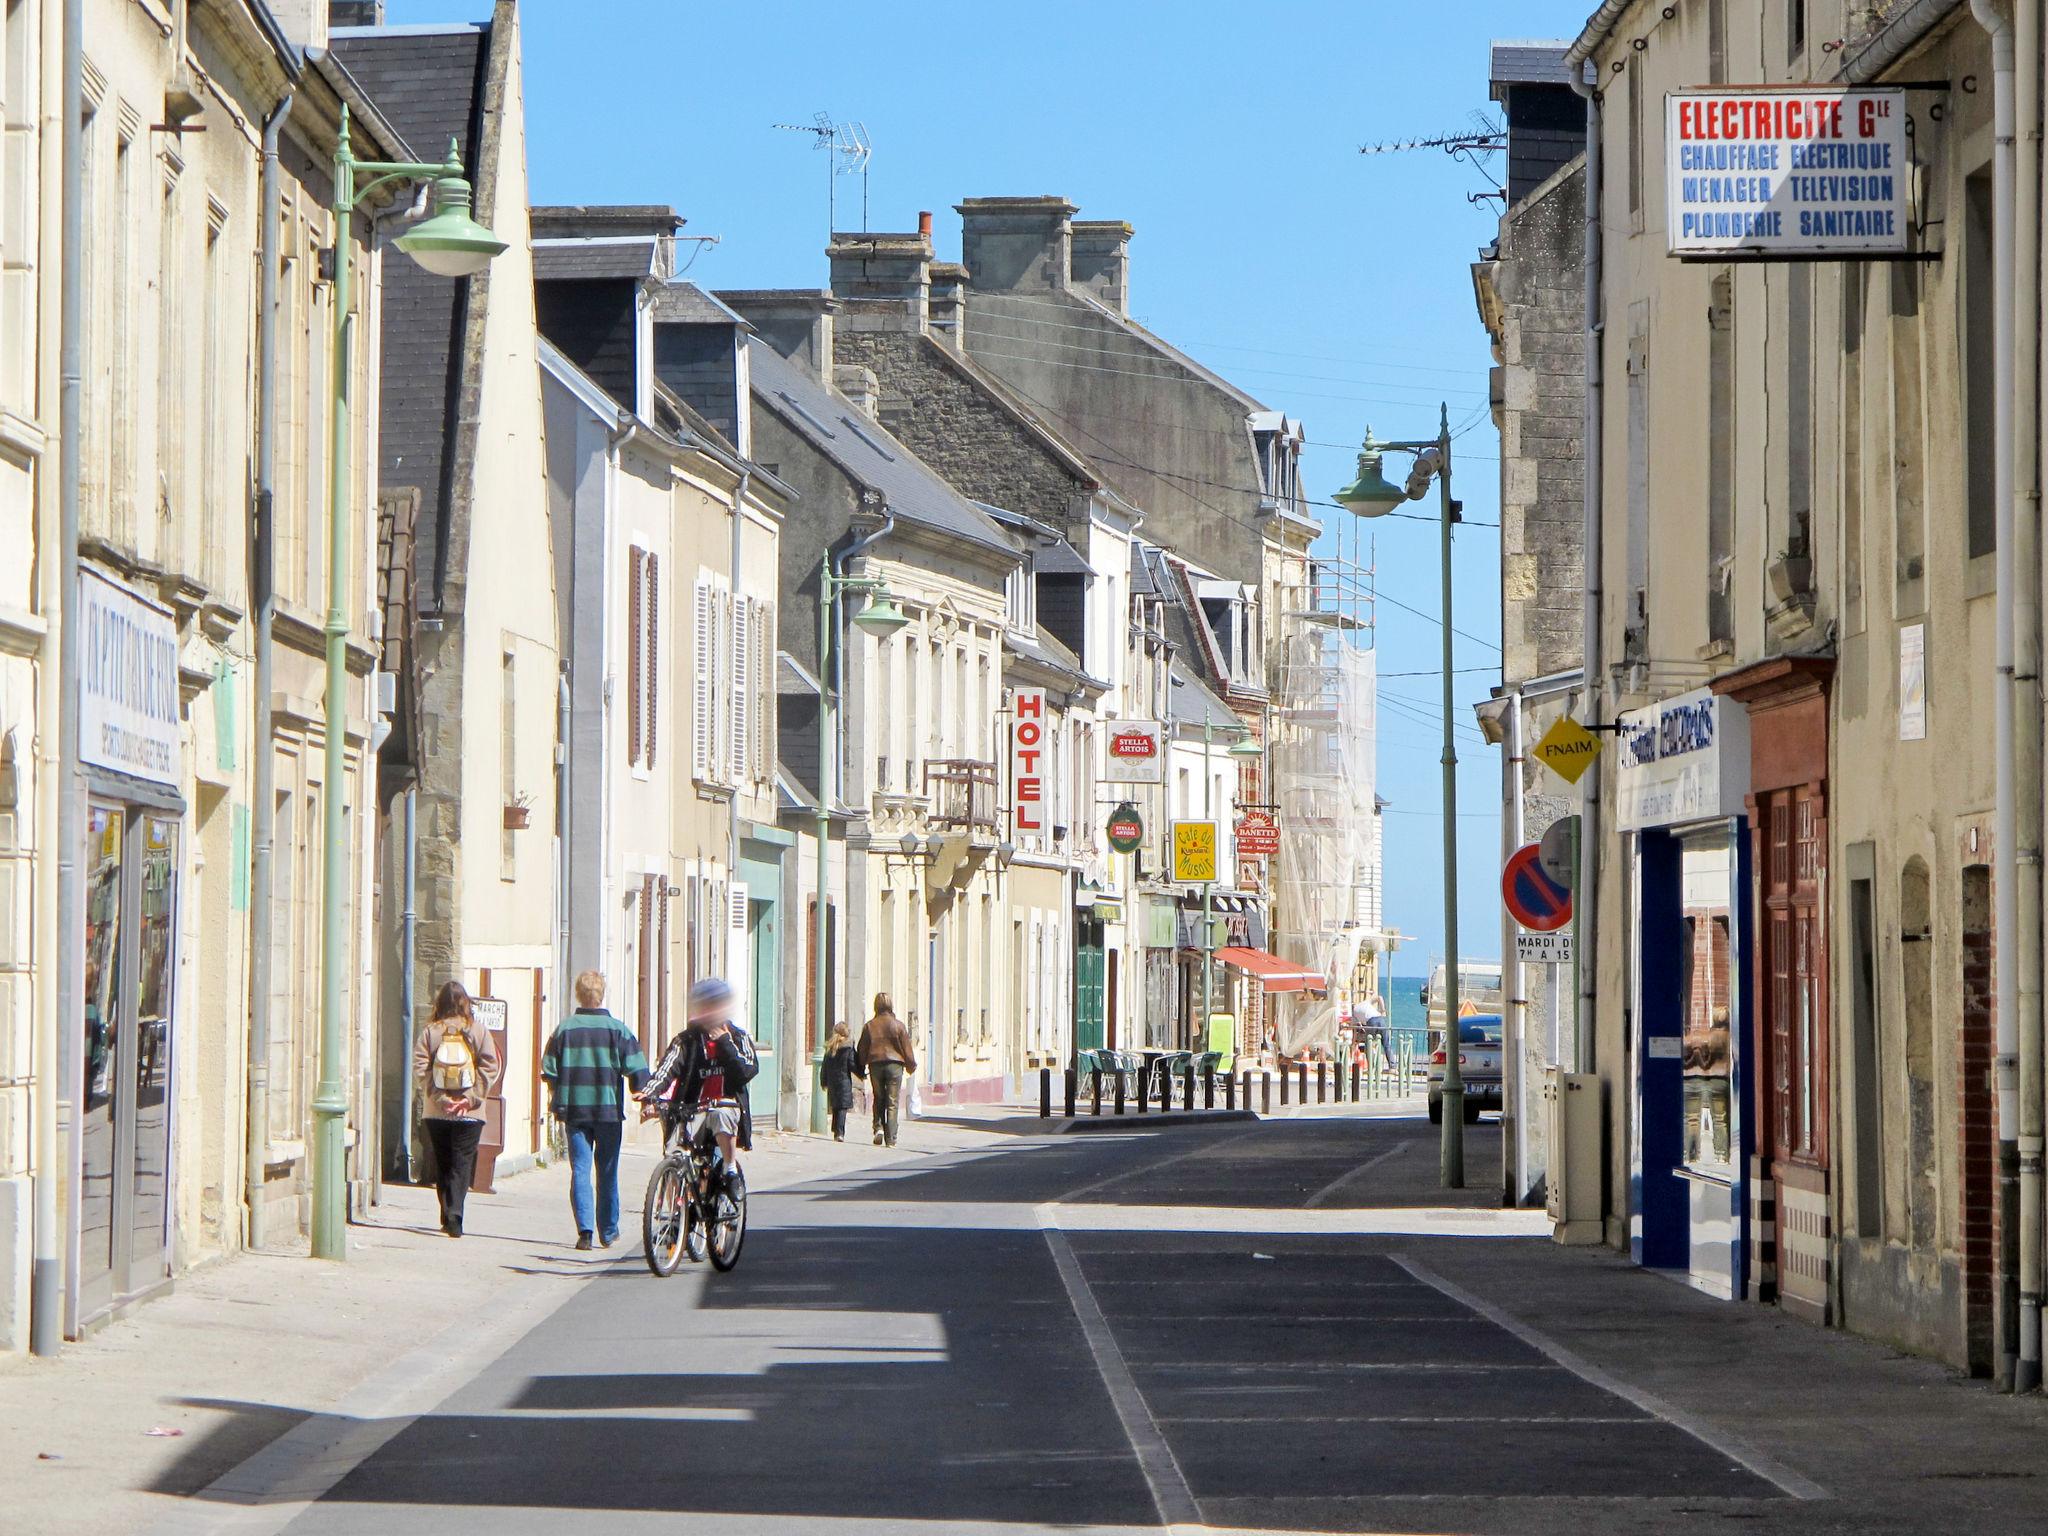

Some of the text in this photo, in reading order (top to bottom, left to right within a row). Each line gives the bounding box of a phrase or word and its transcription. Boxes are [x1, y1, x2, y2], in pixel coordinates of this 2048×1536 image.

[1680, 101, 1841, 140] ELECTRICITE
[1681, 143, 1891, 171] CHAUFFAGE ELECTRIQUE
[1683, 175, 1893, 203] MENAGER TELEVISION
[1683, 210, 1894, 238] PLOMBERIE SANITAIRE
[1119, 738, 1149, 746] STELLA
[1119, 745, 1149, 753] ARTOIS
[1545, 740, 1593, 757] FNAIM
[1018, 695, 1040, 829] HOTEL
[1239, 829, 1277, 837] BANETTE
[1518, 937, 1555, 947] MARDI
[1541, 951, 1548, 960] A
